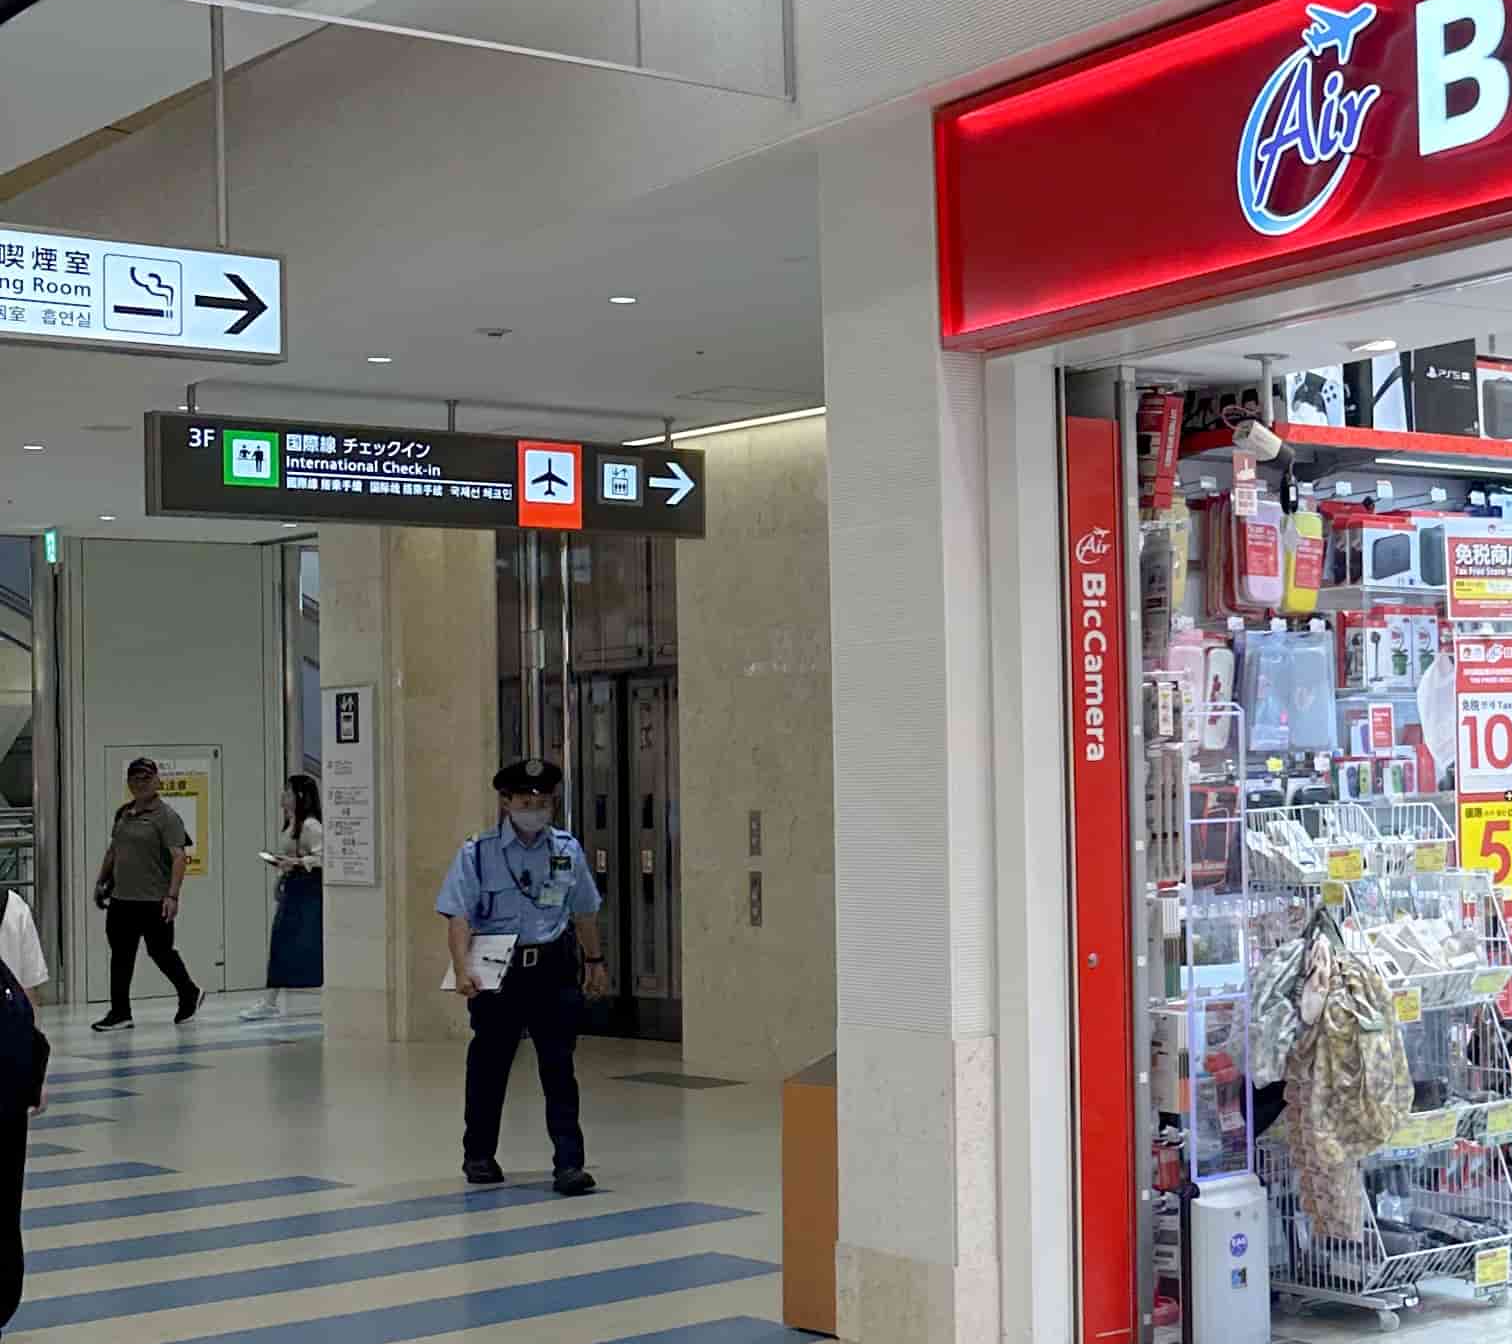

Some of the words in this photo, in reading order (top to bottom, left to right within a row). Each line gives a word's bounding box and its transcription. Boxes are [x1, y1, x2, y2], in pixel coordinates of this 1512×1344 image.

[0, 243, 92, 276] 喫煙室
[33, 277, 92, 297] Room
[41, 308, 92, 328] 흡연실
[187, 427, 216, 448] 3F
[285, 432, 338, 454] 国際線
[342, 437, 432, 459] チェックイン
[286, 455, 380, 473] International
[382, 460, 441, 477] Check-in
[1081, 572, 1108, 762] BicCamera
